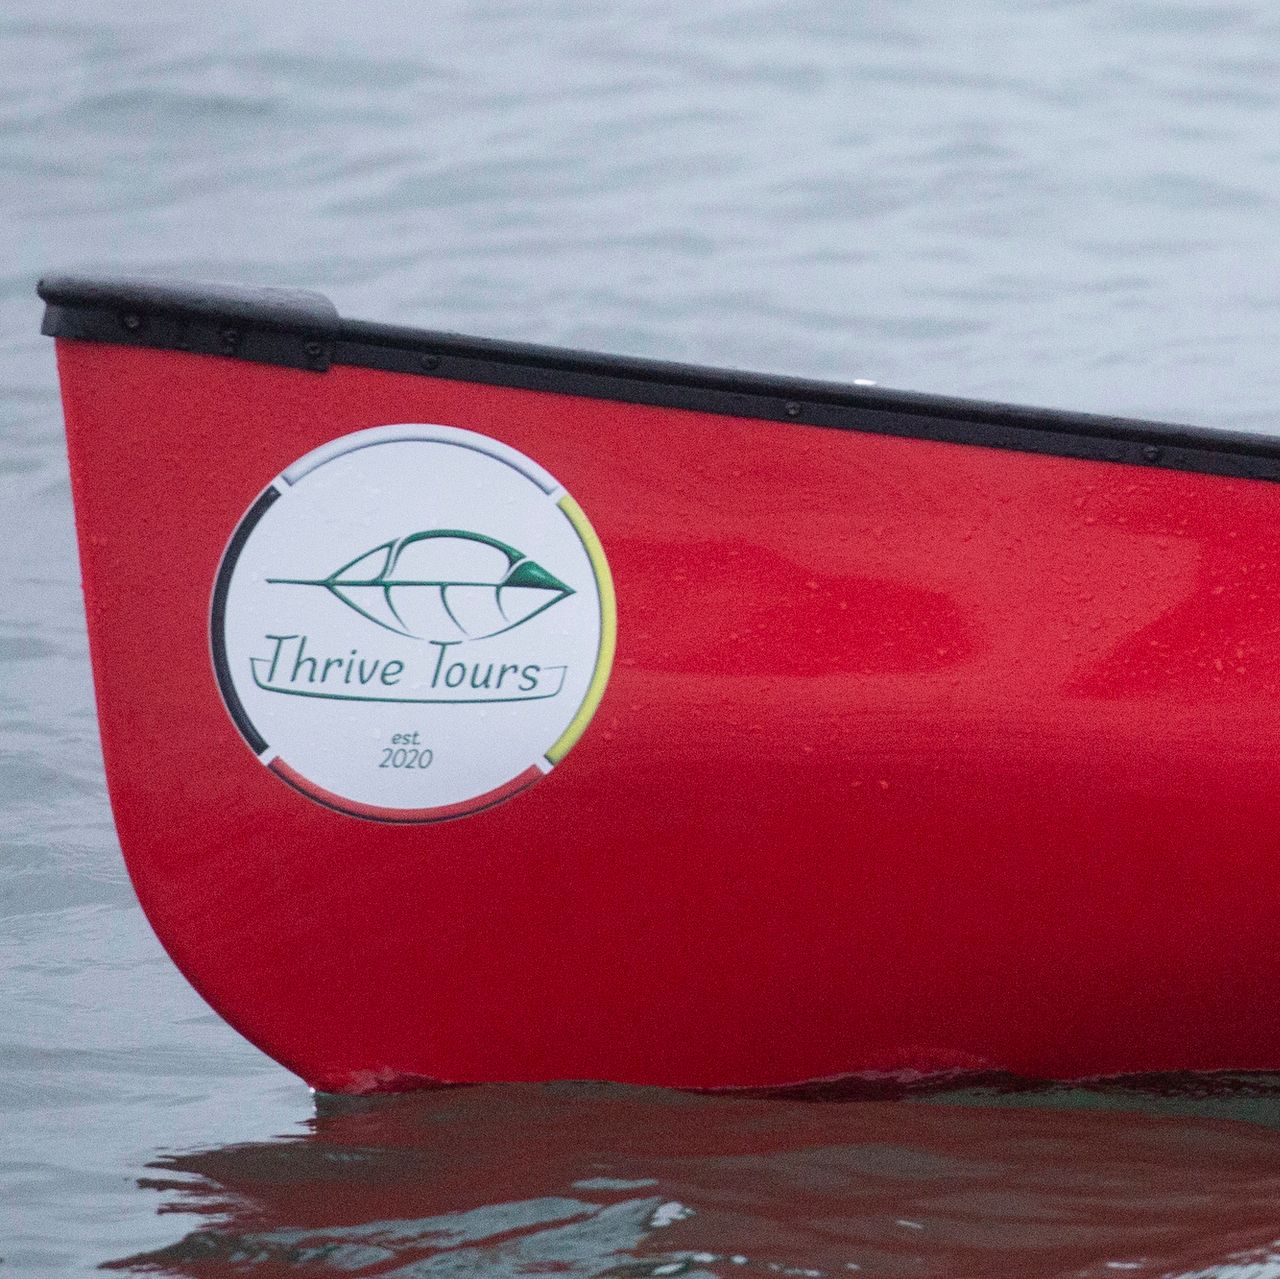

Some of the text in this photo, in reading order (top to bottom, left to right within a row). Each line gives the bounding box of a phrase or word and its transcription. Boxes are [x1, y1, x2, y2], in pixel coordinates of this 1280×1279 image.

[265, 634, 541, 691] Thrive Tours
[379, 747, 433, 769] 2020
